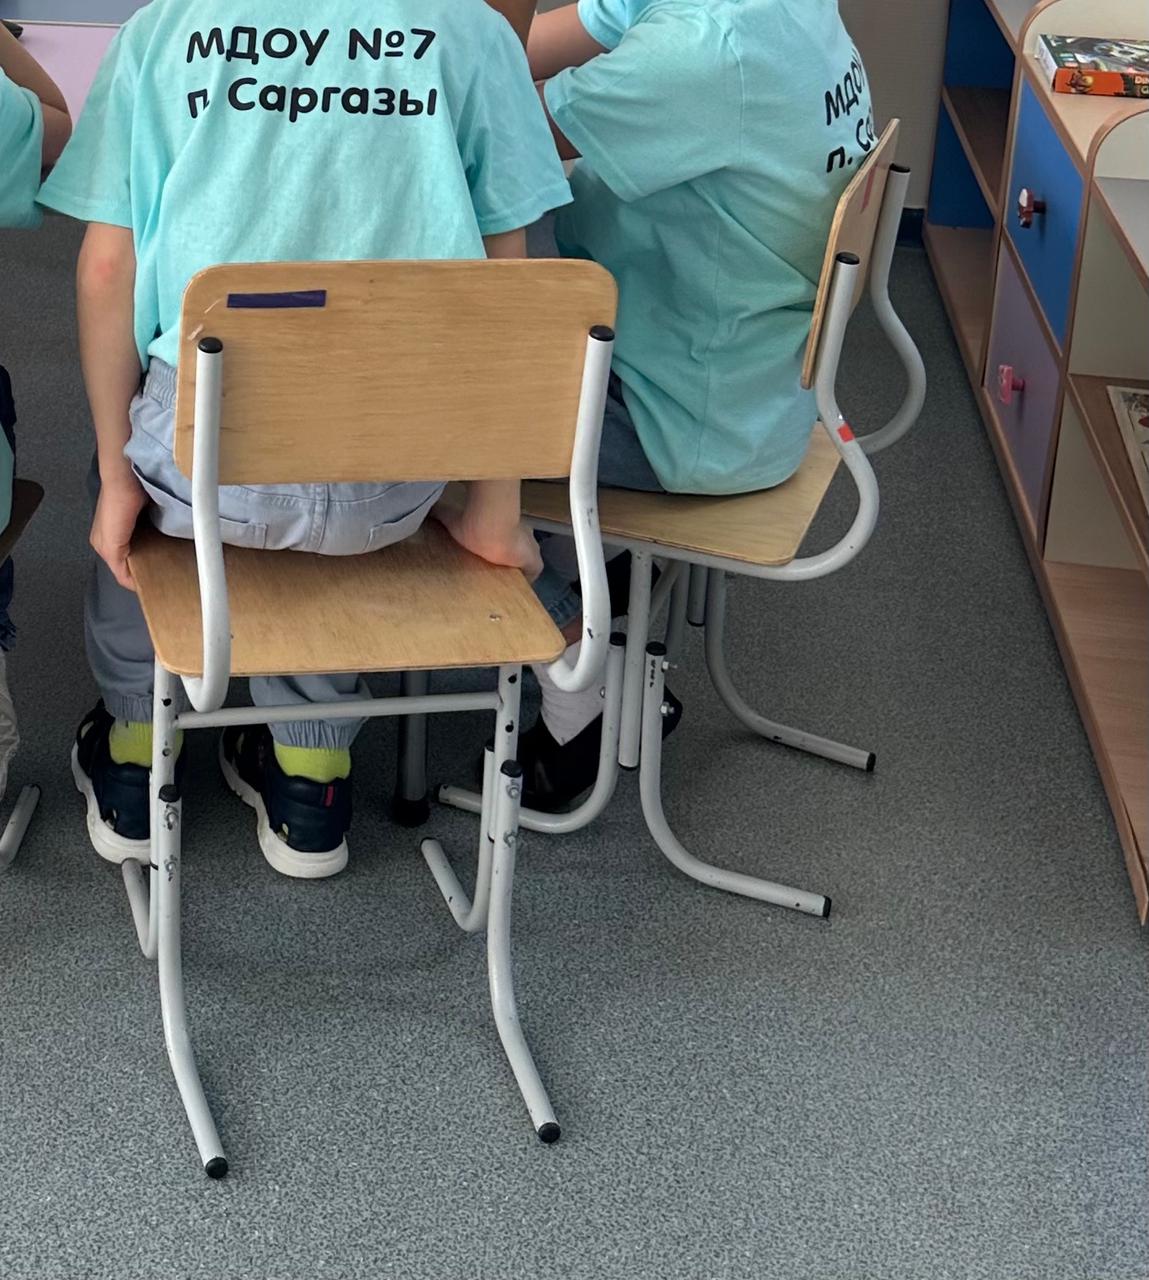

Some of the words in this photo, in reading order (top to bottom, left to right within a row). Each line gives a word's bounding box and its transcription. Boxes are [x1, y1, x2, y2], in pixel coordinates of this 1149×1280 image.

[186, 25, 329, 67] МДОУ
[348, 27, 437, 61] №7
[227, 77, 439, 123] Саргазы
[826, 146, 853, 173] п.
